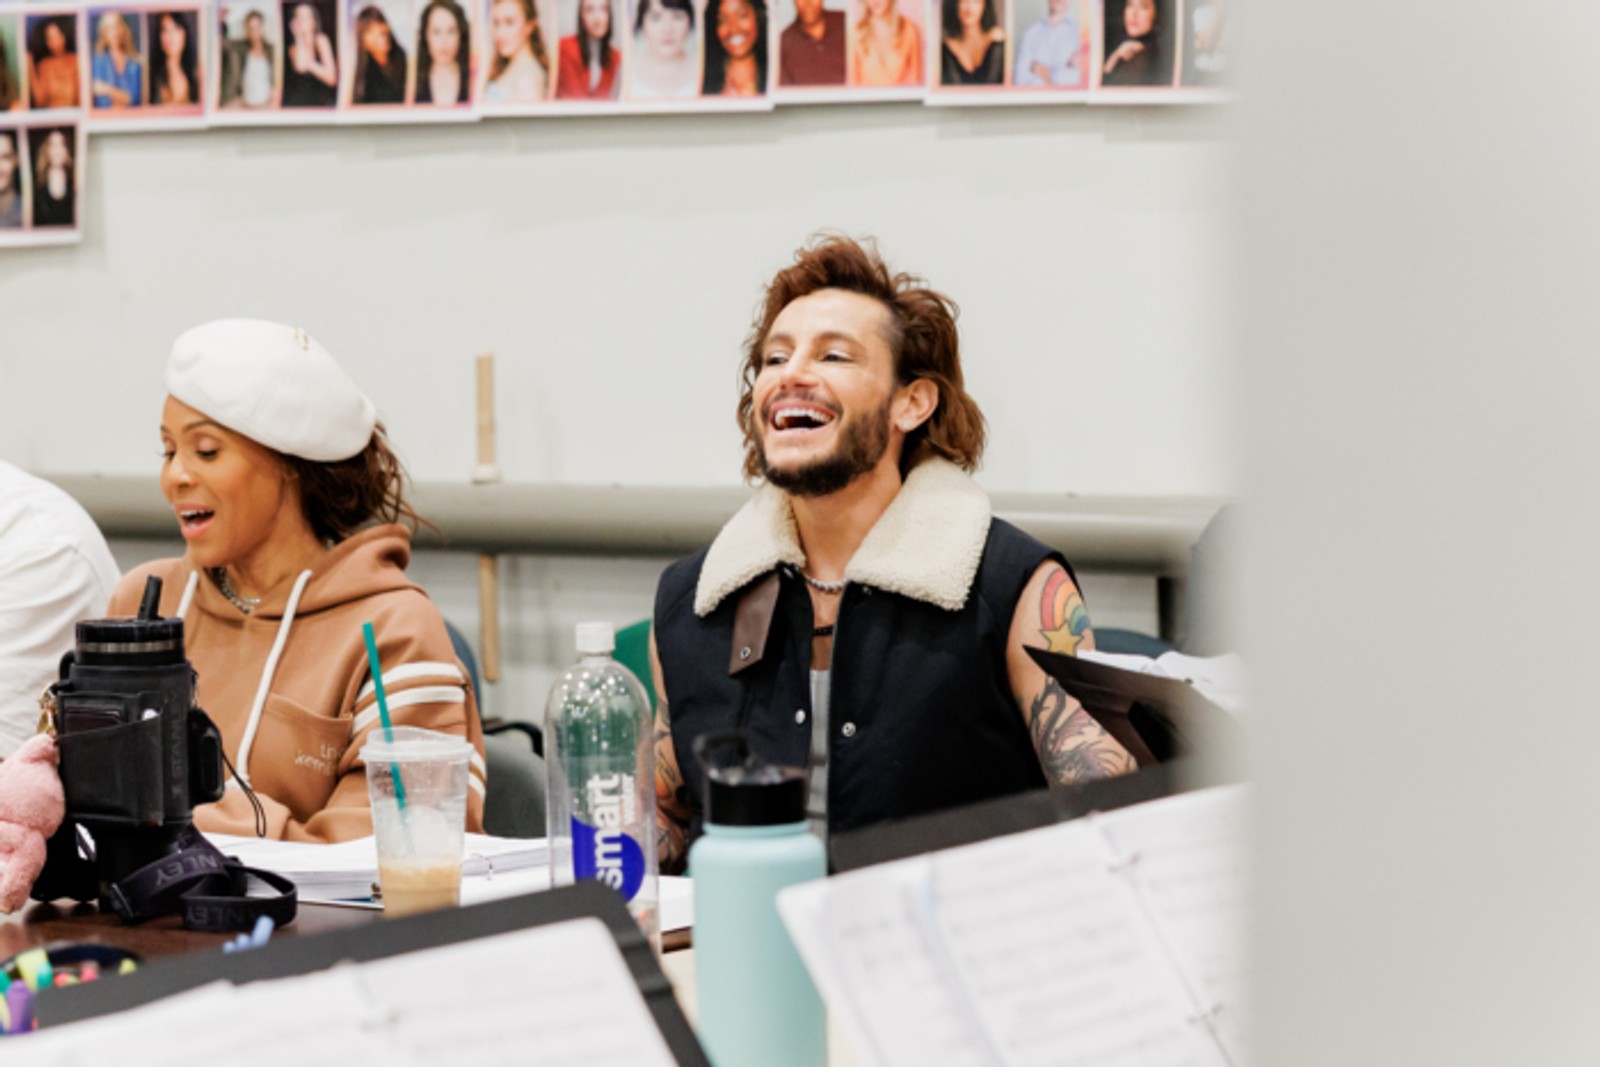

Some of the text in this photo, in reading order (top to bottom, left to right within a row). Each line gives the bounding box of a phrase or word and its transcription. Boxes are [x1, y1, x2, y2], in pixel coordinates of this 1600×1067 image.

[170, 690, 183, 778] STANLEY
[156, 854, 220, 886] NLEY
[586, 774, 623, 890] smart
